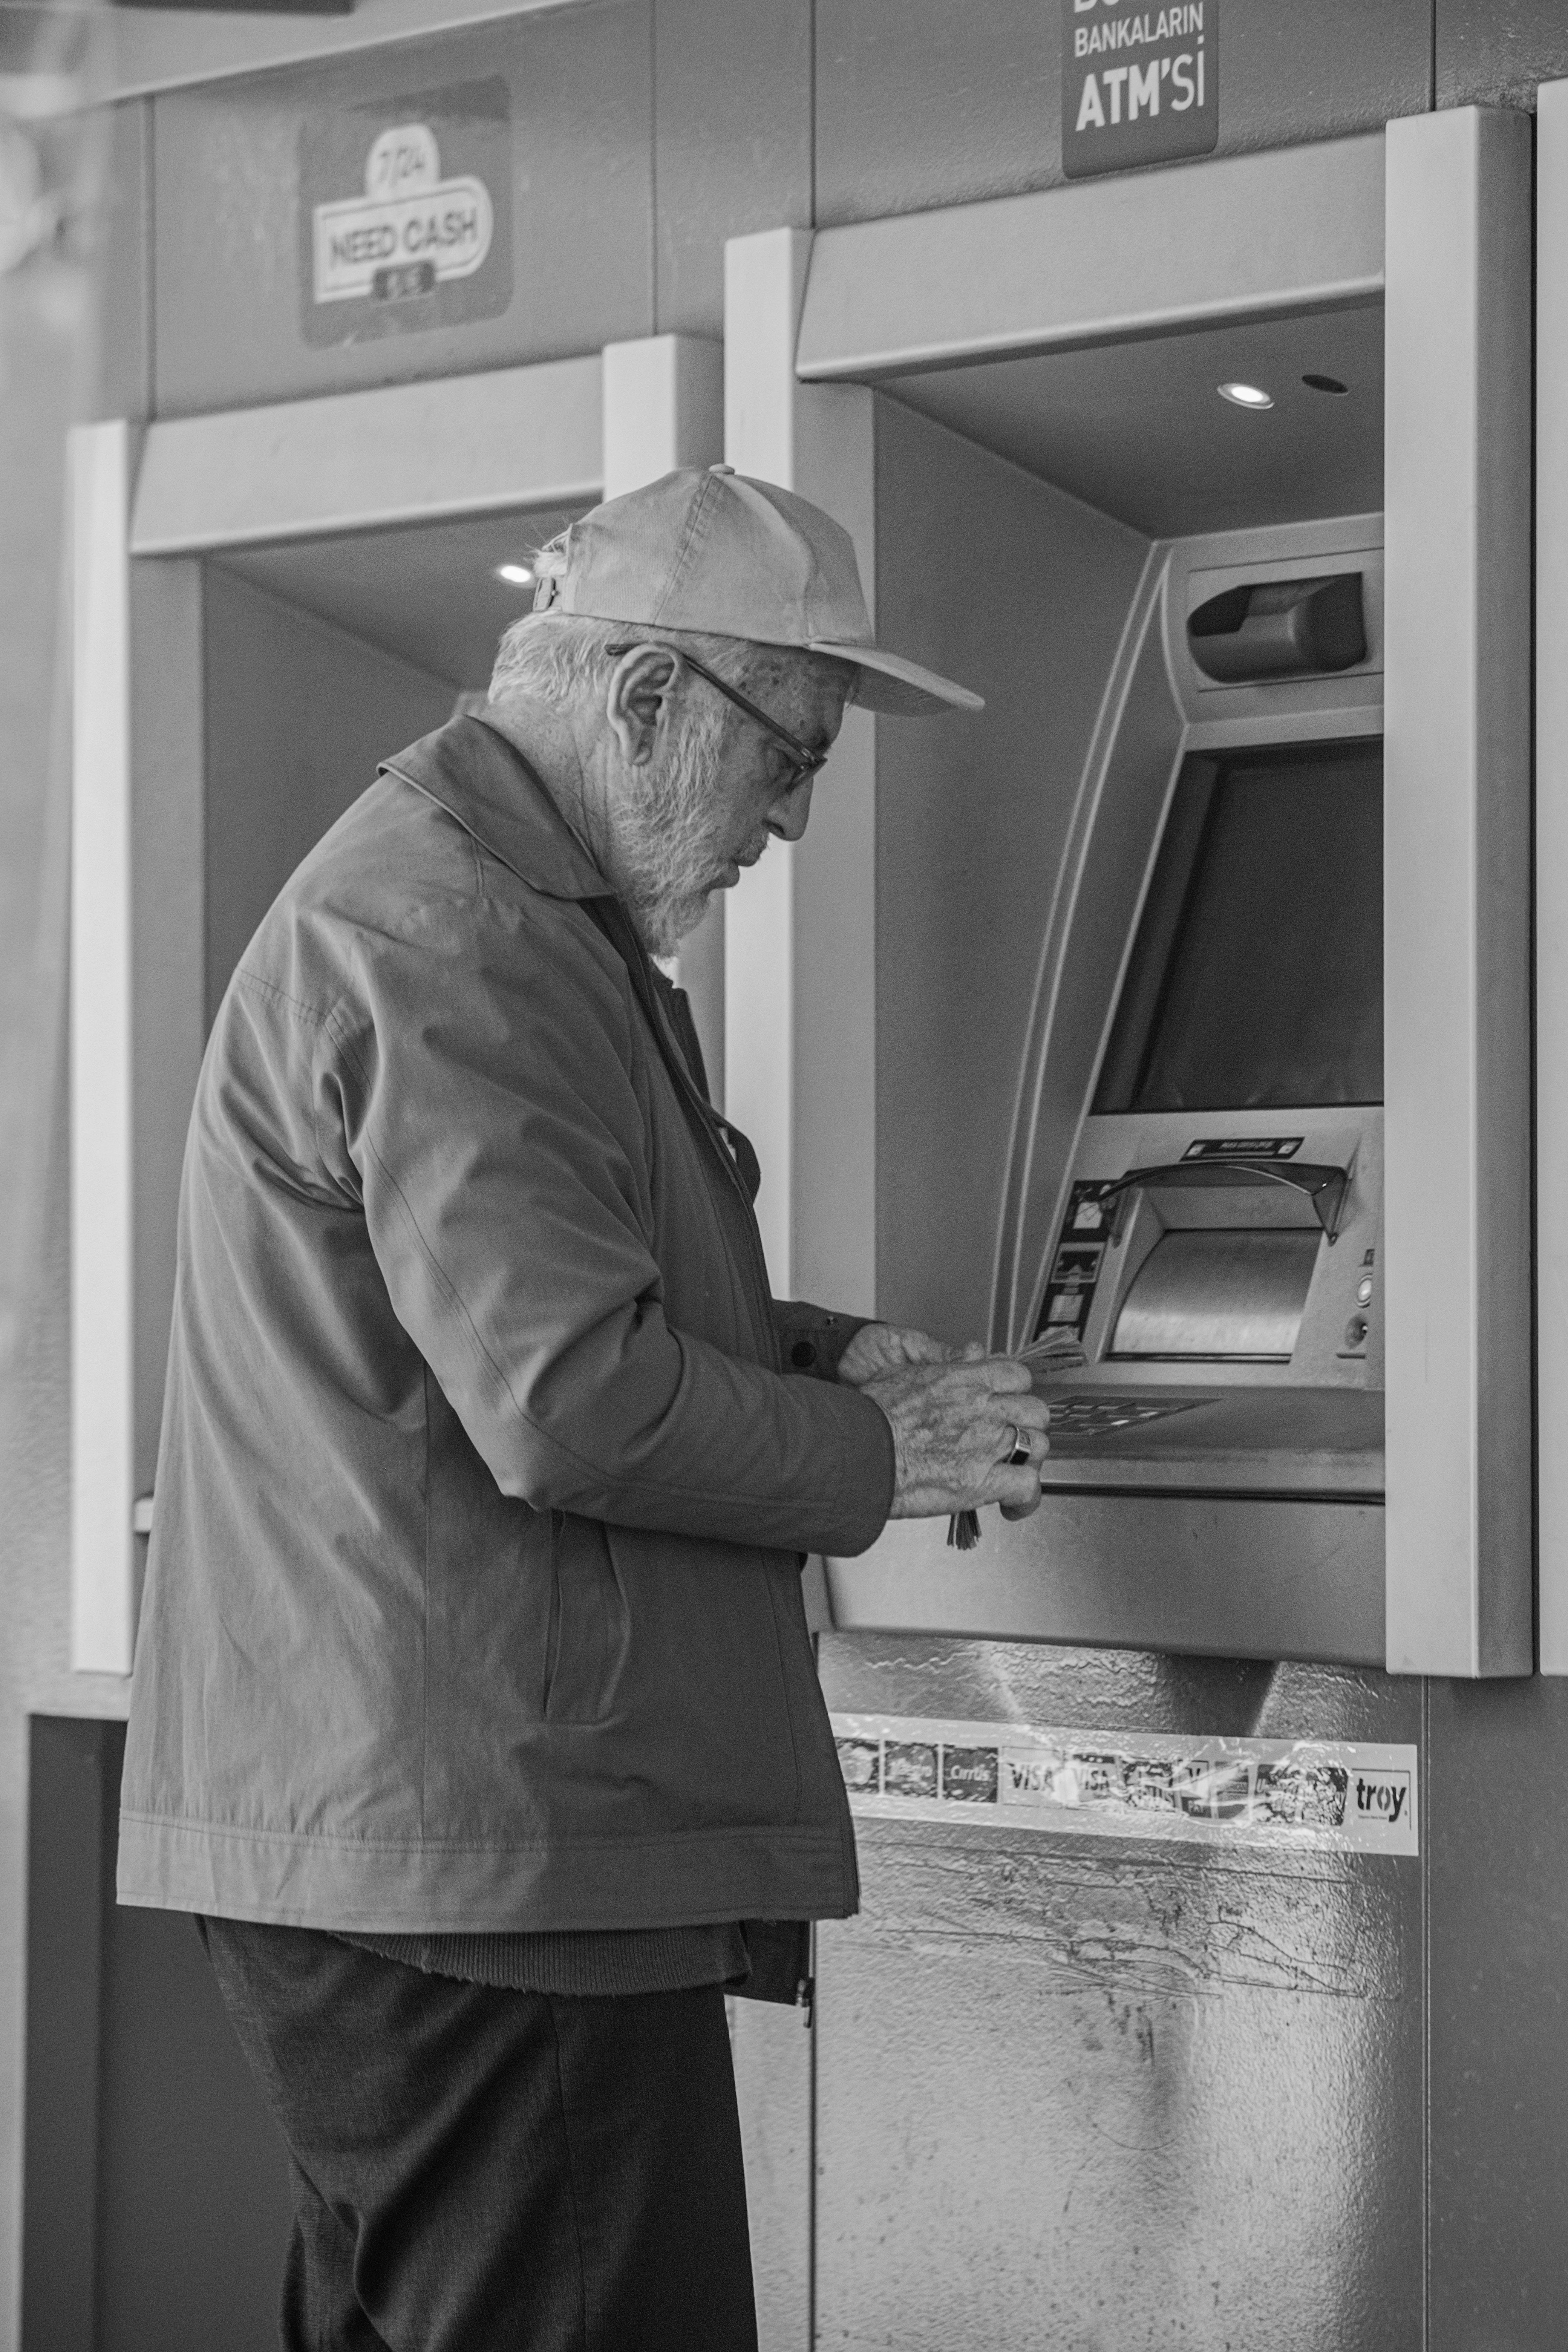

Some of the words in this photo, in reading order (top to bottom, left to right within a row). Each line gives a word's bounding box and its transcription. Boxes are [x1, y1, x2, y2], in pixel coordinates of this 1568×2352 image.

[1075, 2, 1204, 58] BANKALARIN
[1075, 35, 1205, 131] ATM'Sİ
[330, 224, 398, 271] NEED
[403, 207, 478, 254] CASH
[950, 1764, 991, 1781] Cirrus
[1007, 1763, 1055, 1792] VISA
[1357, 1778, 1407, 1822] troy
